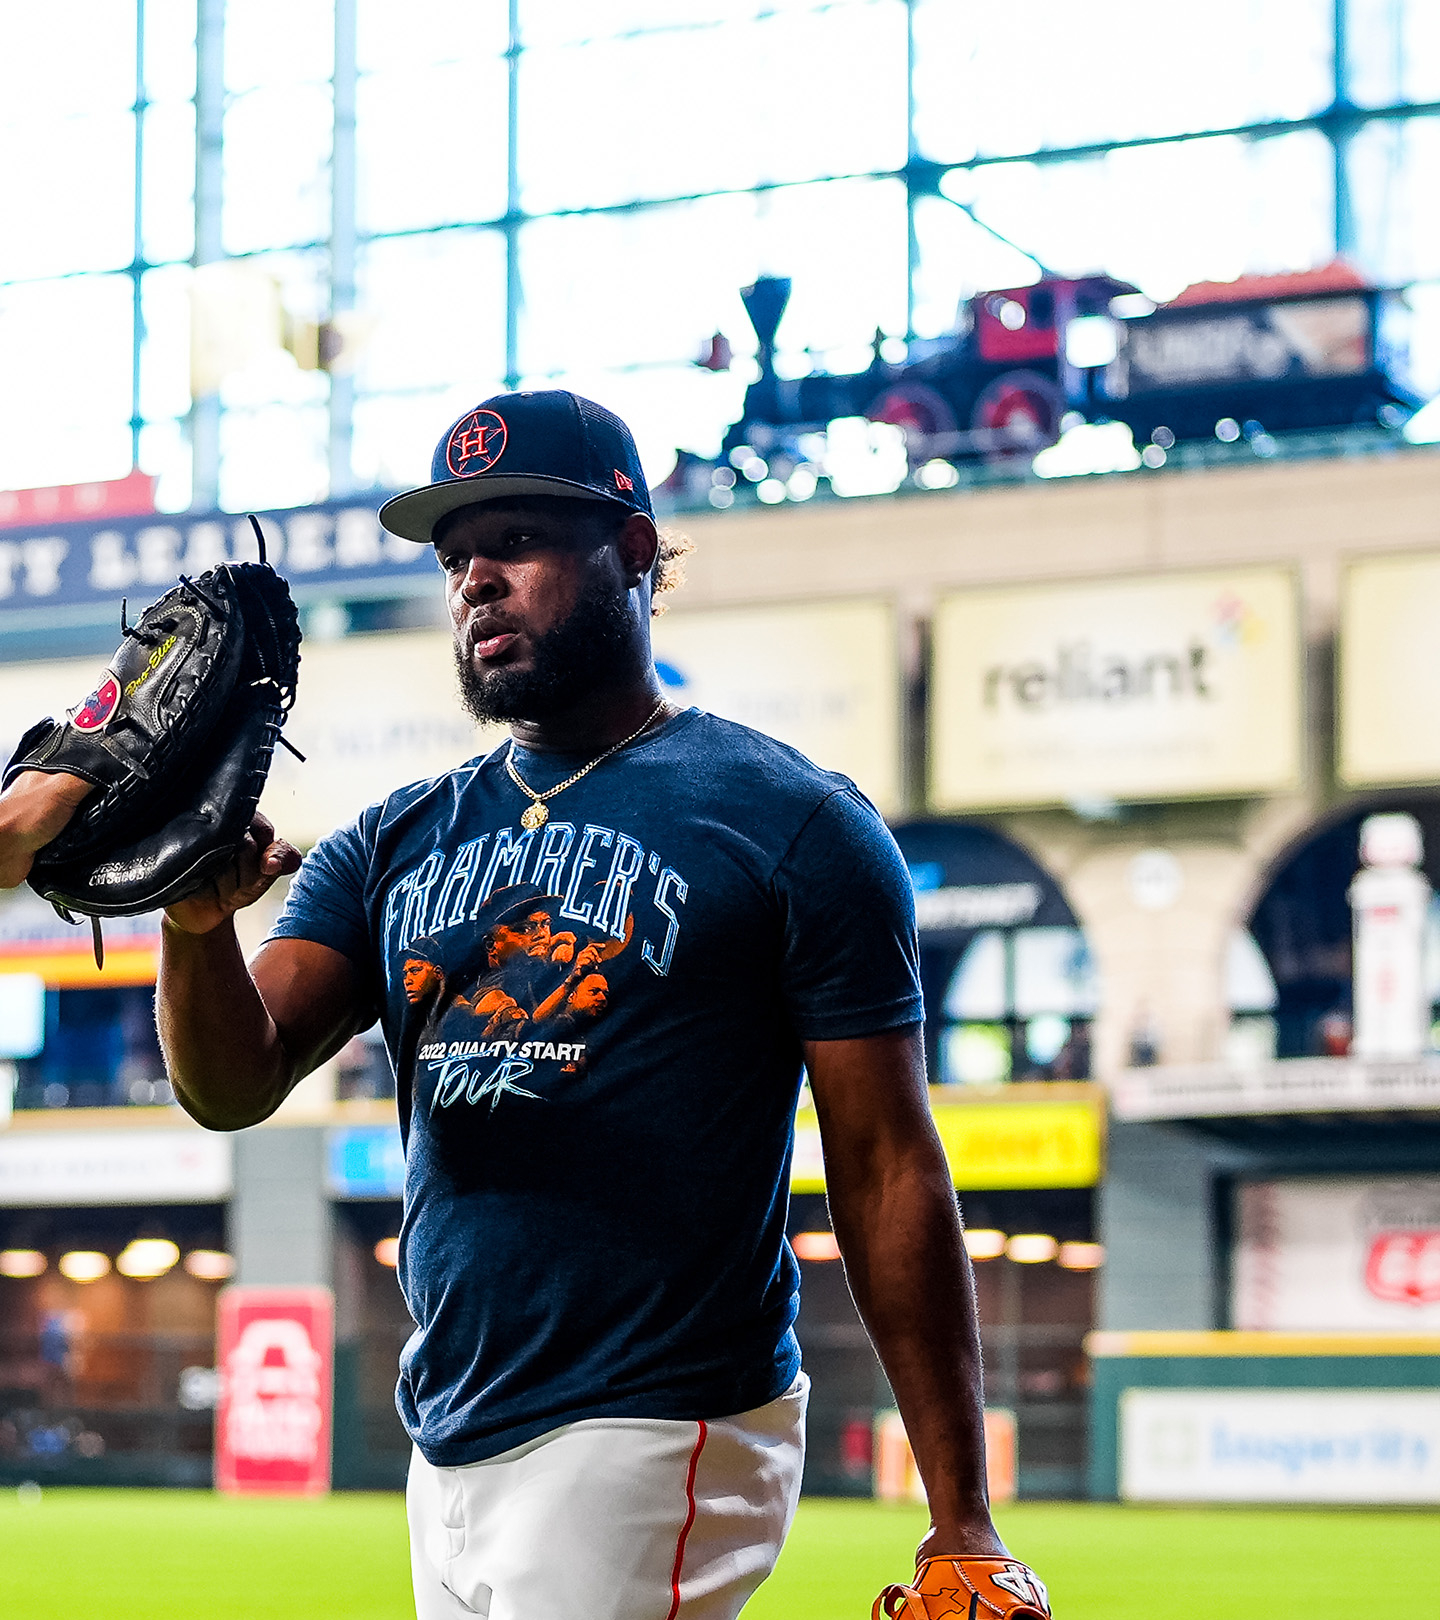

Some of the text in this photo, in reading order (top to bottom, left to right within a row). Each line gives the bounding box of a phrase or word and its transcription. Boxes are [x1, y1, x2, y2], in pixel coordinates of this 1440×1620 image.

[458, 426, 489, 461] H
[983, 637, 1216, 712] reliant
[383, 822, 689, 991] FRAMBER'S
[418, 1040, 586, 1061] 2022 QUALITY START
